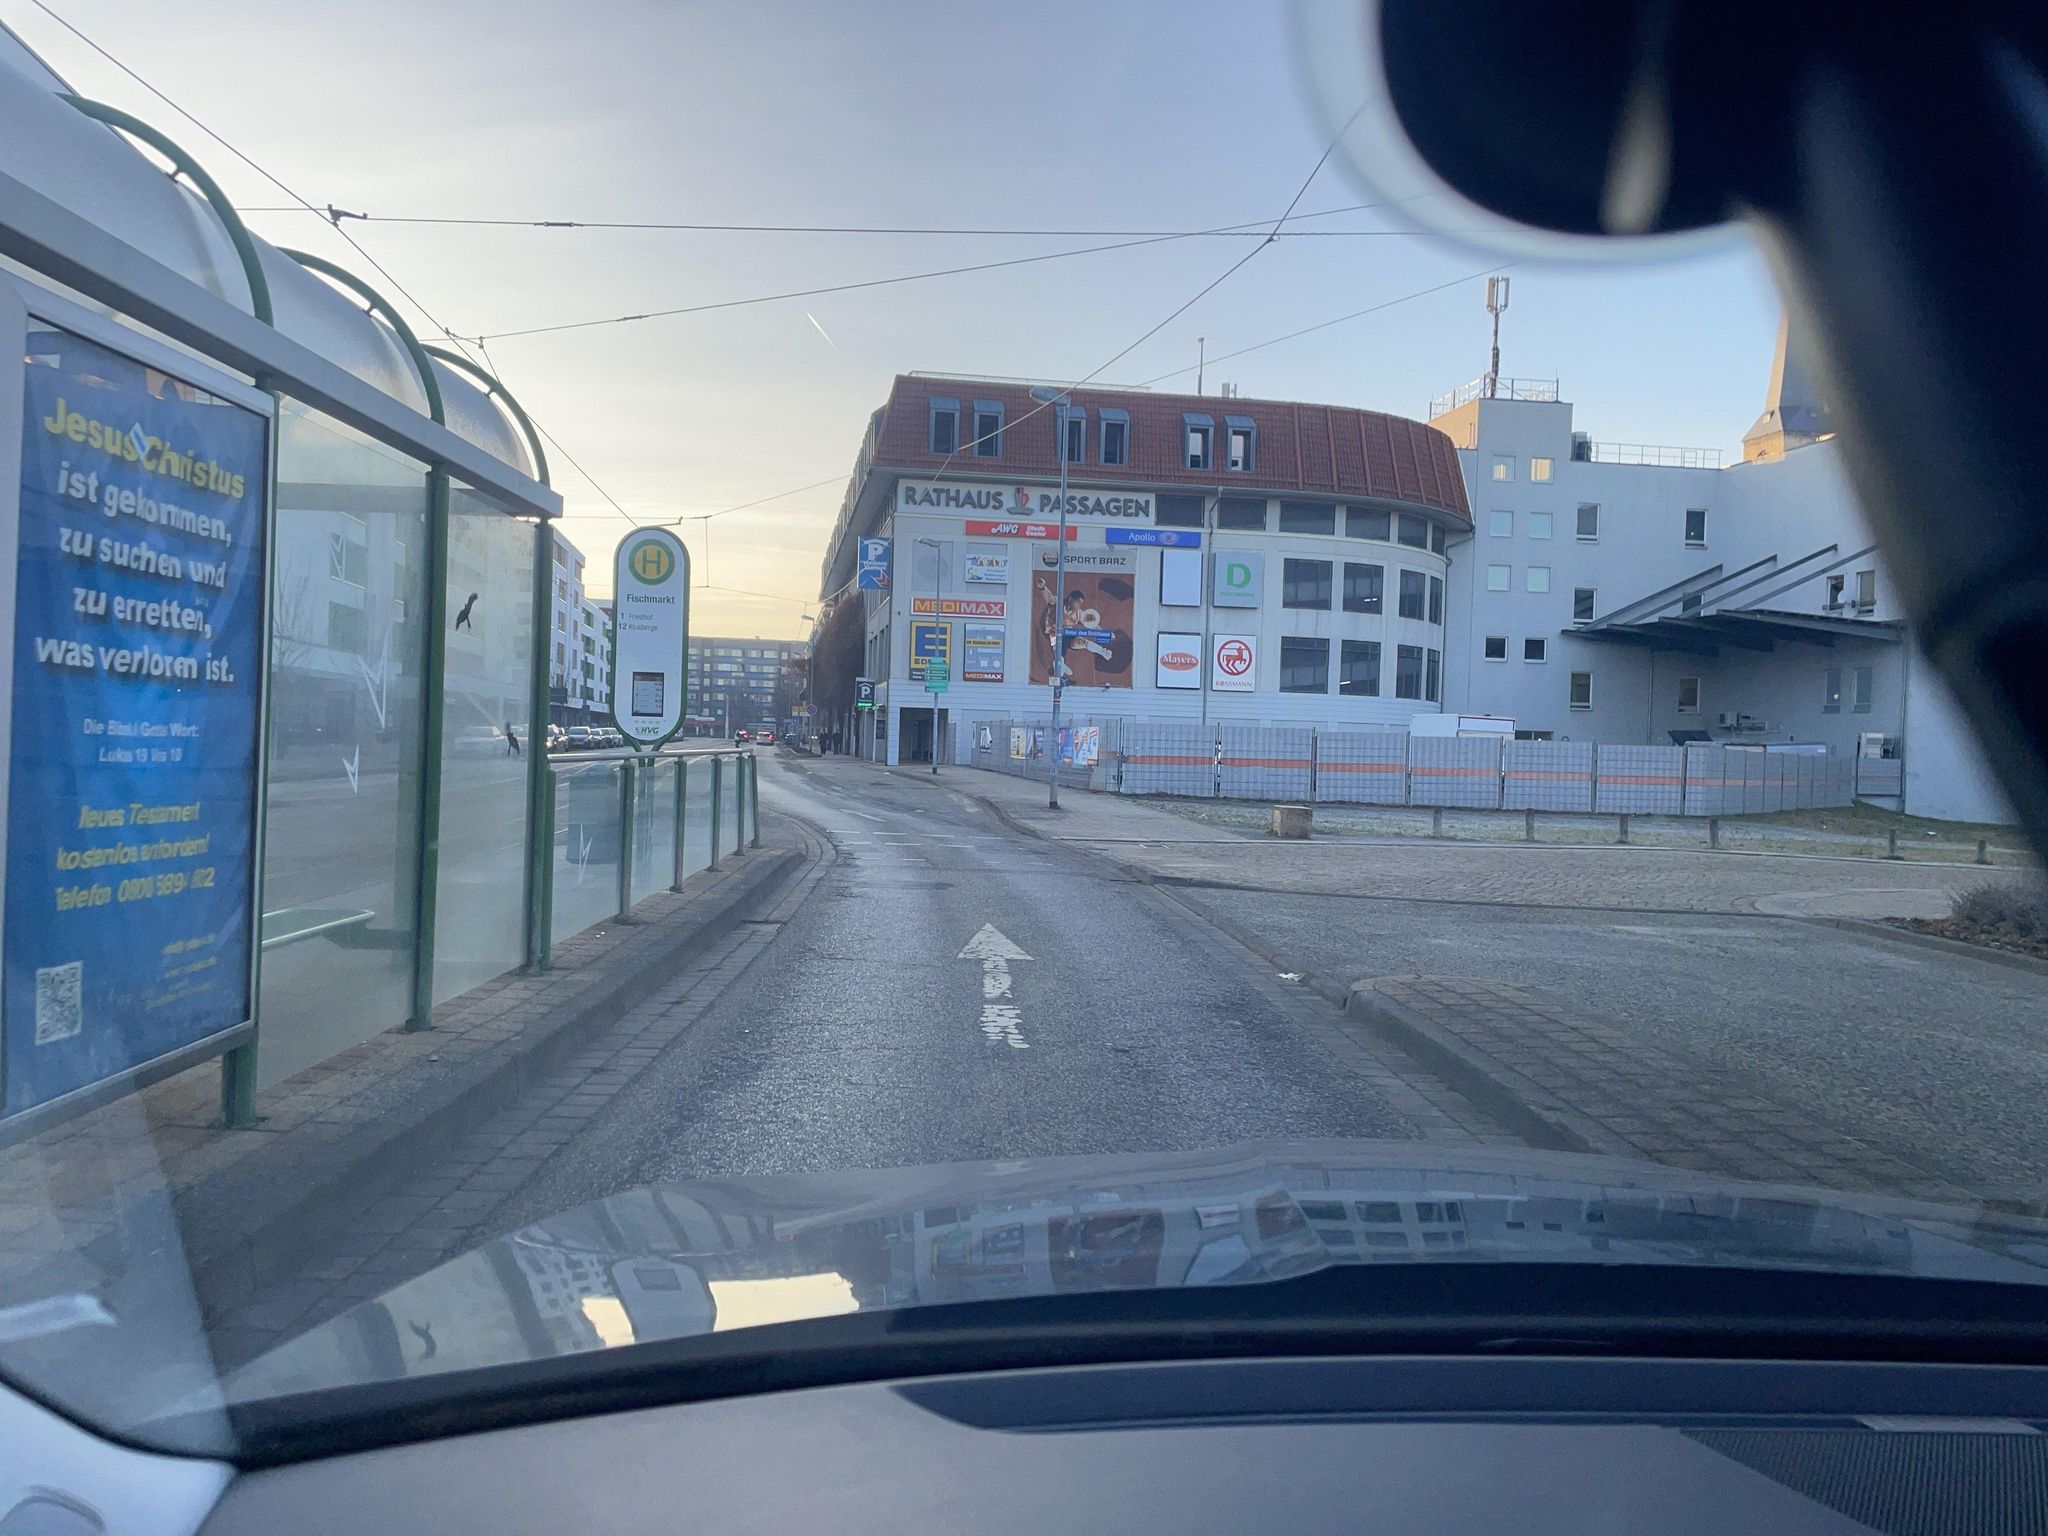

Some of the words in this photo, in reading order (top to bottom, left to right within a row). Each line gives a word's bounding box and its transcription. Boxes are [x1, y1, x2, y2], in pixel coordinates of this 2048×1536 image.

[43, 397, 139, 462] Jesus
[143, 435, 245, 498] Christus
[57, 461, 99, 503] ist
[103, 484, 232, 547] gekommen,
[905, 486, 1004, 511] RATHAUS
[1039, 493, 1150, 518] PASSAGEN
[991, 523, 1019, 534] AWG
[1128, 532, 1156, 543] Apollo
[59, 526, 94, 557] zu
[99, 537, 182, 579] suchen
[188, 560, 227, 588] und
[641, 549, 661, 575] H
[1064, 555, 1097, 565] SPORT
[1099, 556, 1127, 566] BARZ
[627, 594, 675, 604] Fischmarkt
[73, 587, 107, 615] zu
[113, 595, 212, 639] erretten,
[914, 600, 1002, 615] MEDIMAX
[619, 622, 627, 630] 12
[98, 645, 198, 679] verloren
[206, 652, 235, 682] ist.
[1162, 654, 1197, 666] Mayers
[83, 719, 105, 735] Die
